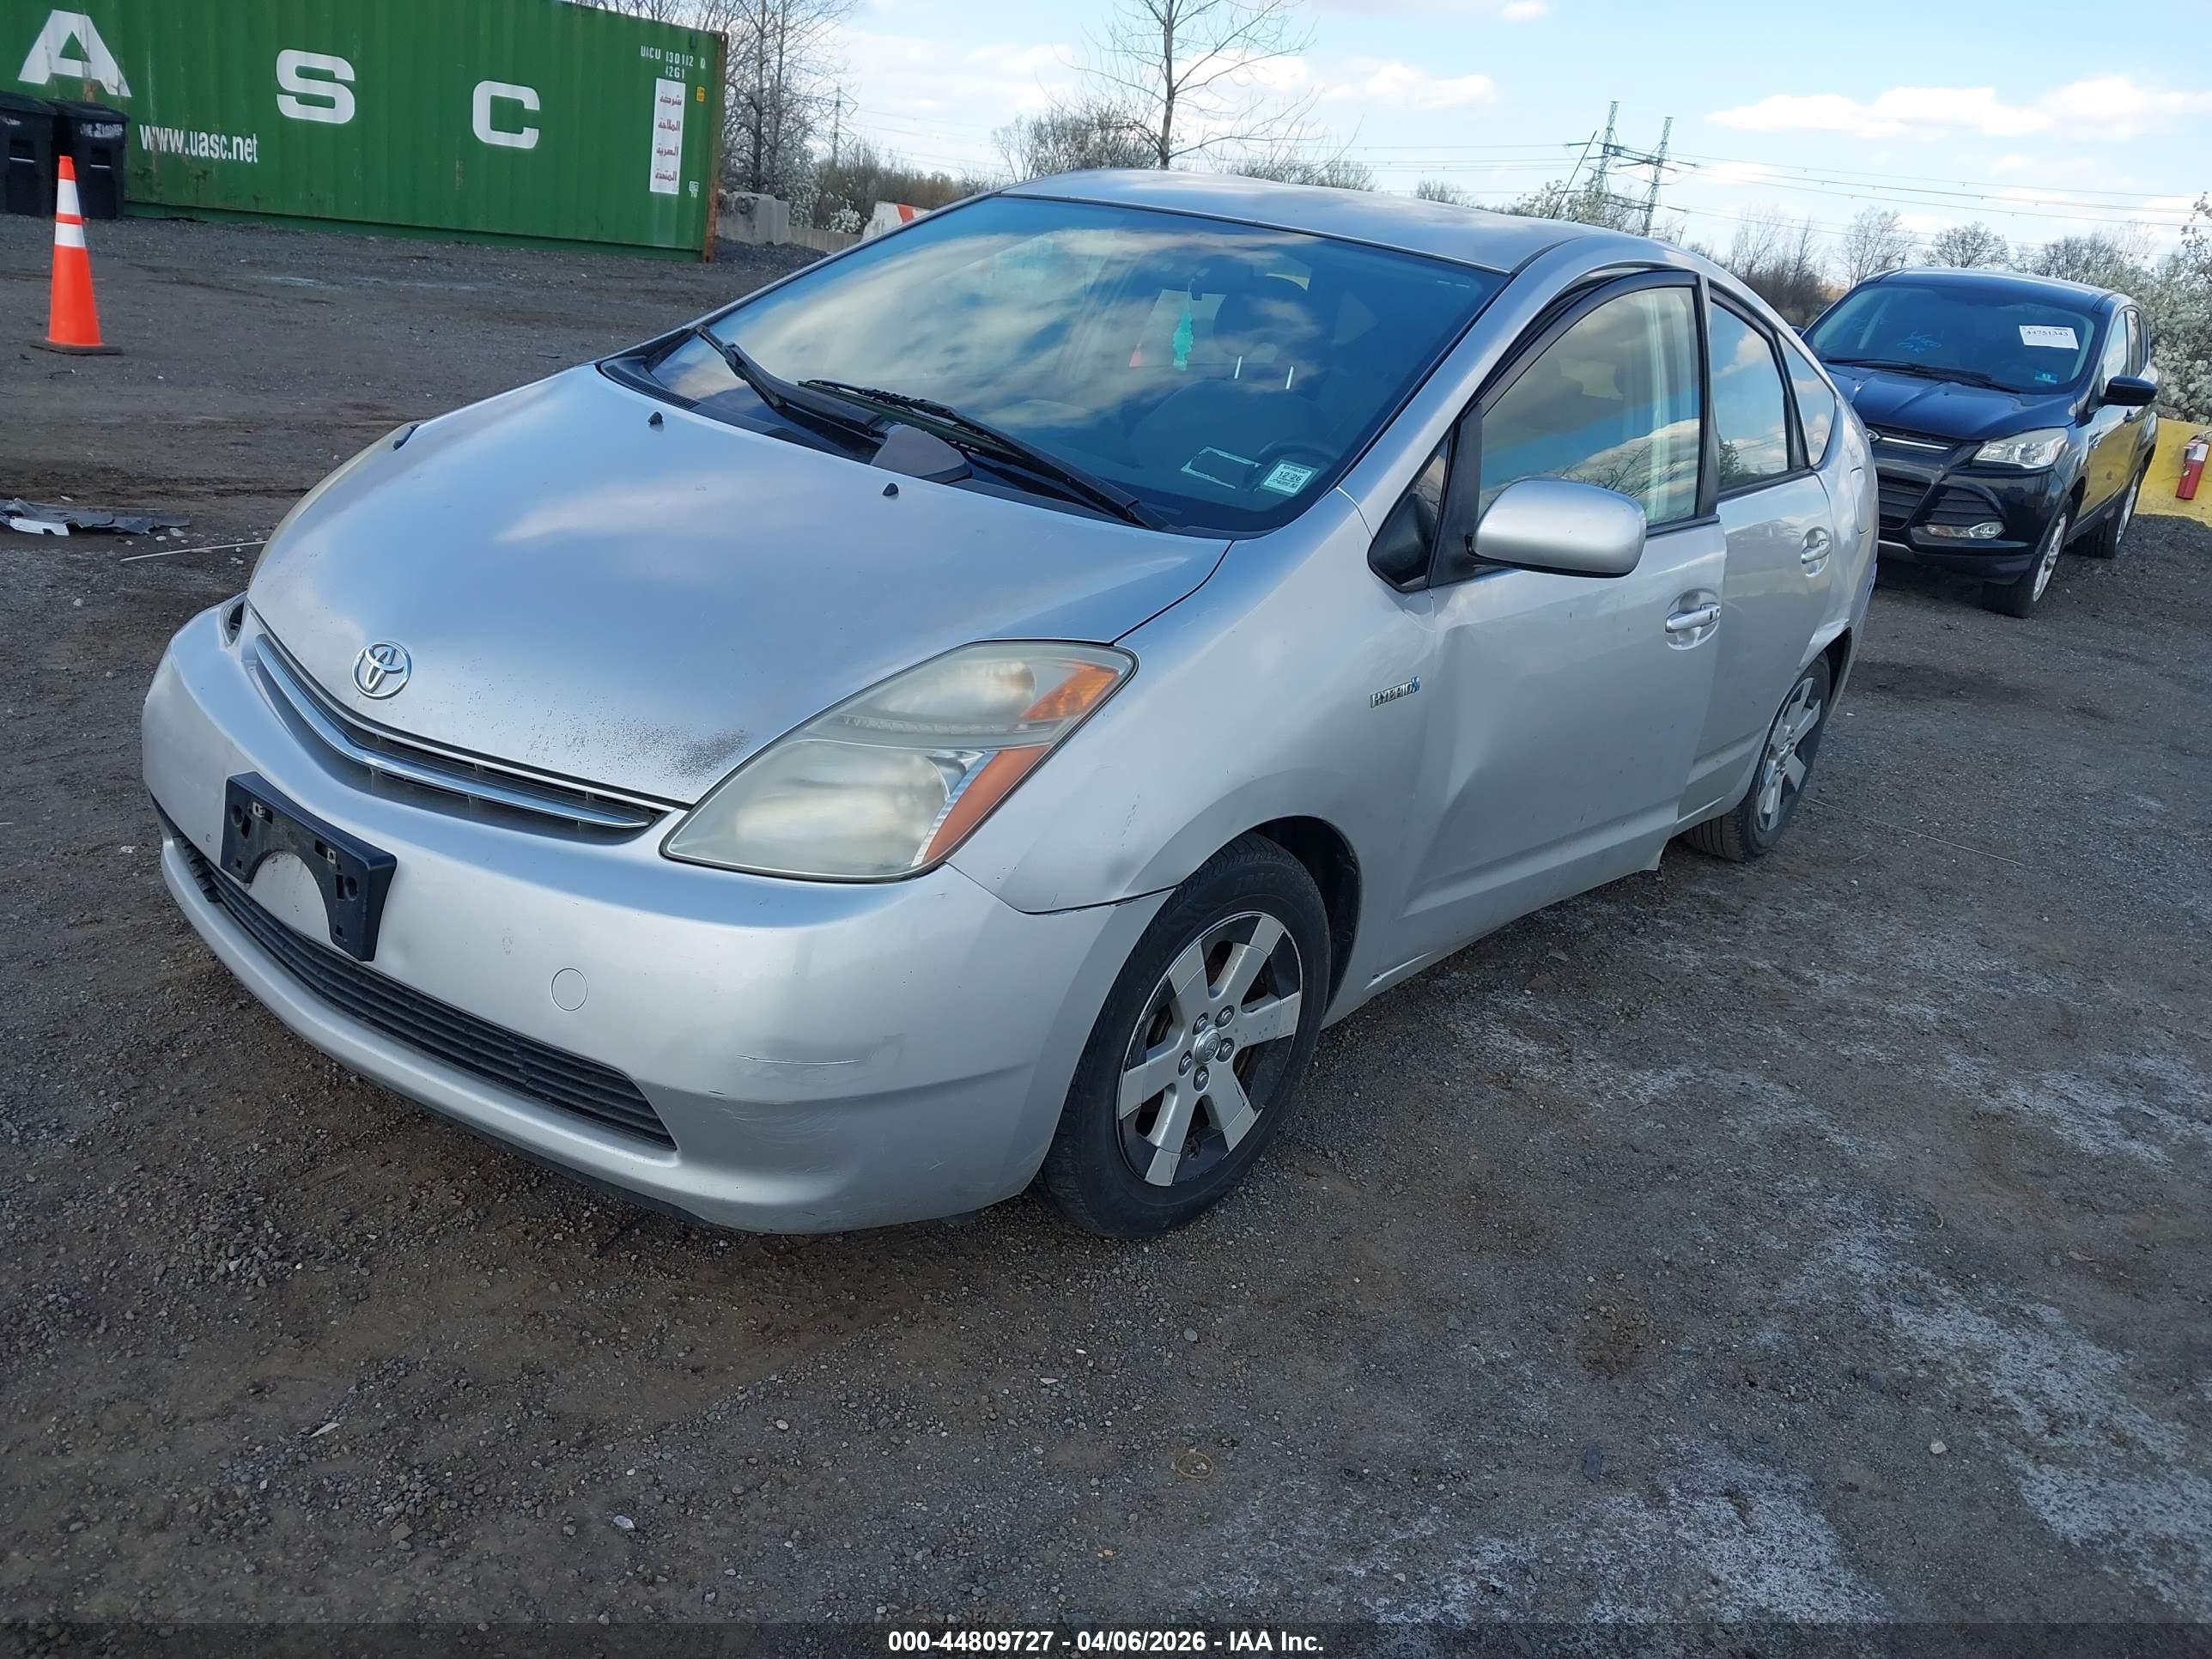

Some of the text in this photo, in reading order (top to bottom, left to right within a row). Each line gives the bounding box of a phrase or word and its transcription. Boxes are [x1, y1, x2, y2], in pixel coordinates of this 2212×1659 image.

[18, 9, 541, 149] A S C
[138, 124, 258, 163] www.uasc.net
